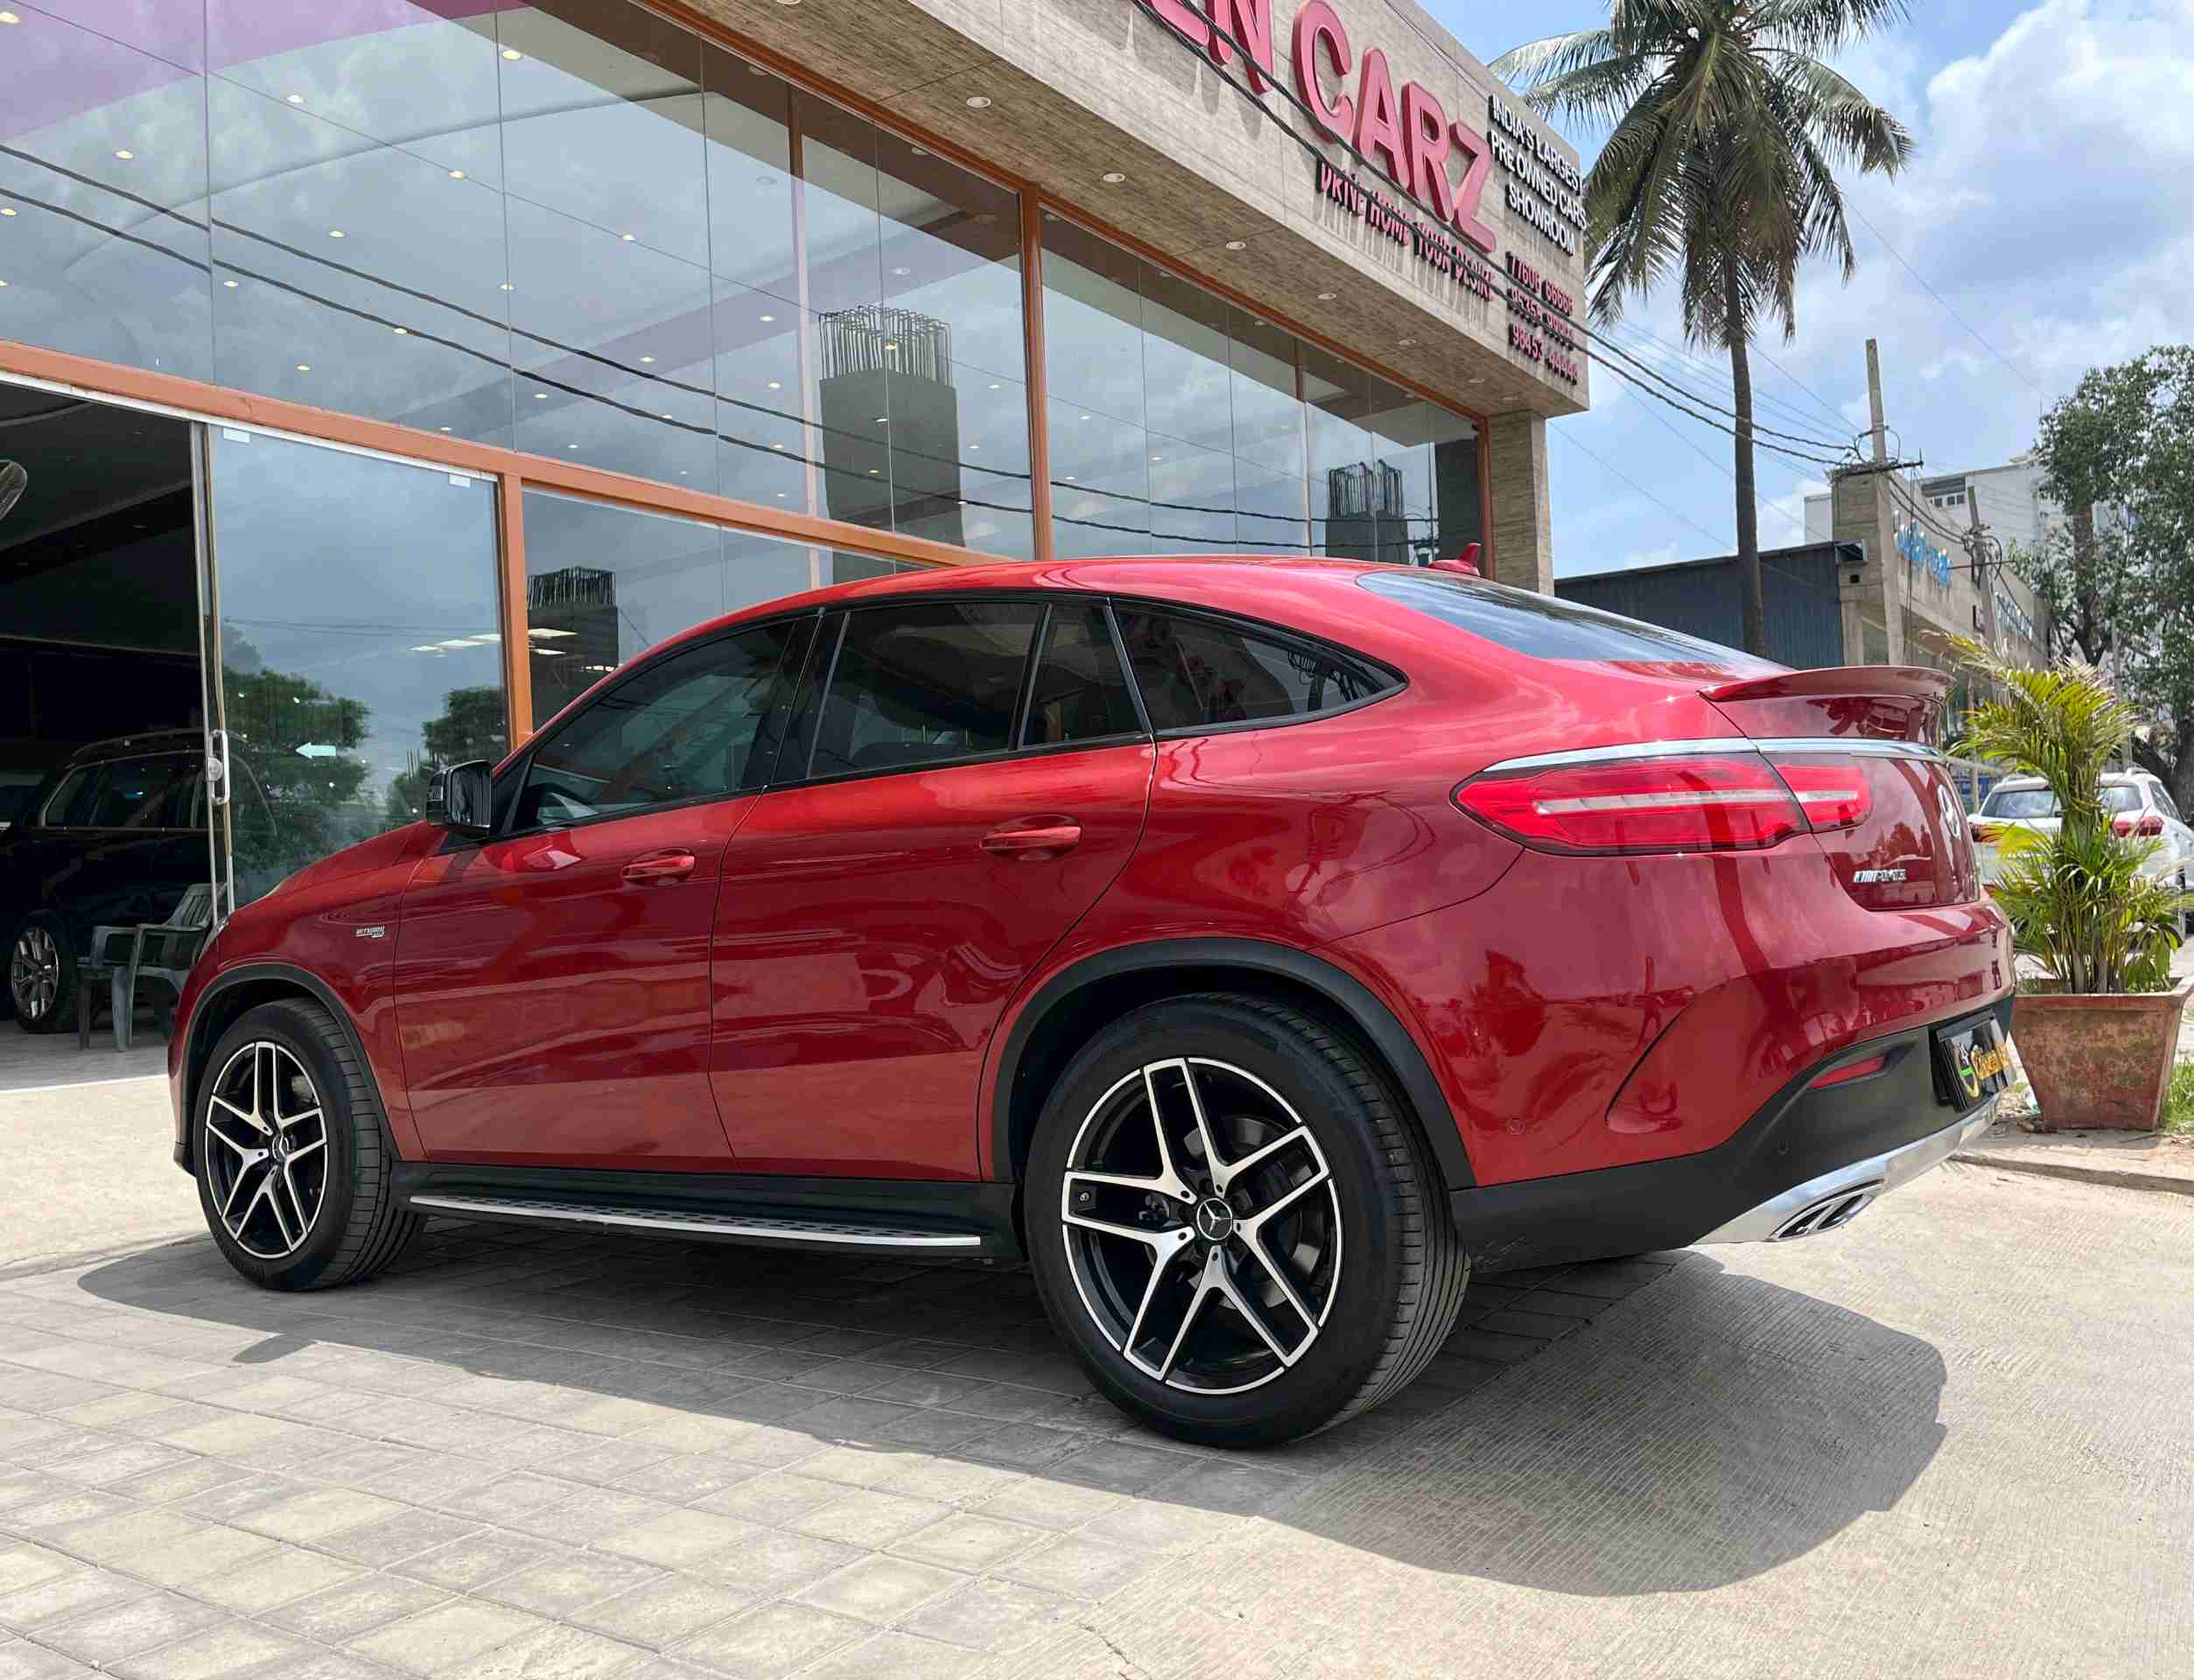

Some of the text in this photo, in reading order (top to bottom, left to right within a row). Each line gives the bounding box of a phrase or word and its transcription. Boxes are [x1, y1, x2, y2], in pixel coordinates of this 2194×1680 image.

[1292, 1, 1497, 253] CARZ
[1490, 93, 1583, 196] INDIA'S LARGEST
[1489, 129, 1588, 232] PRE OWNED CARS
[1506, 180, 1576, 256] SHOWROOM
